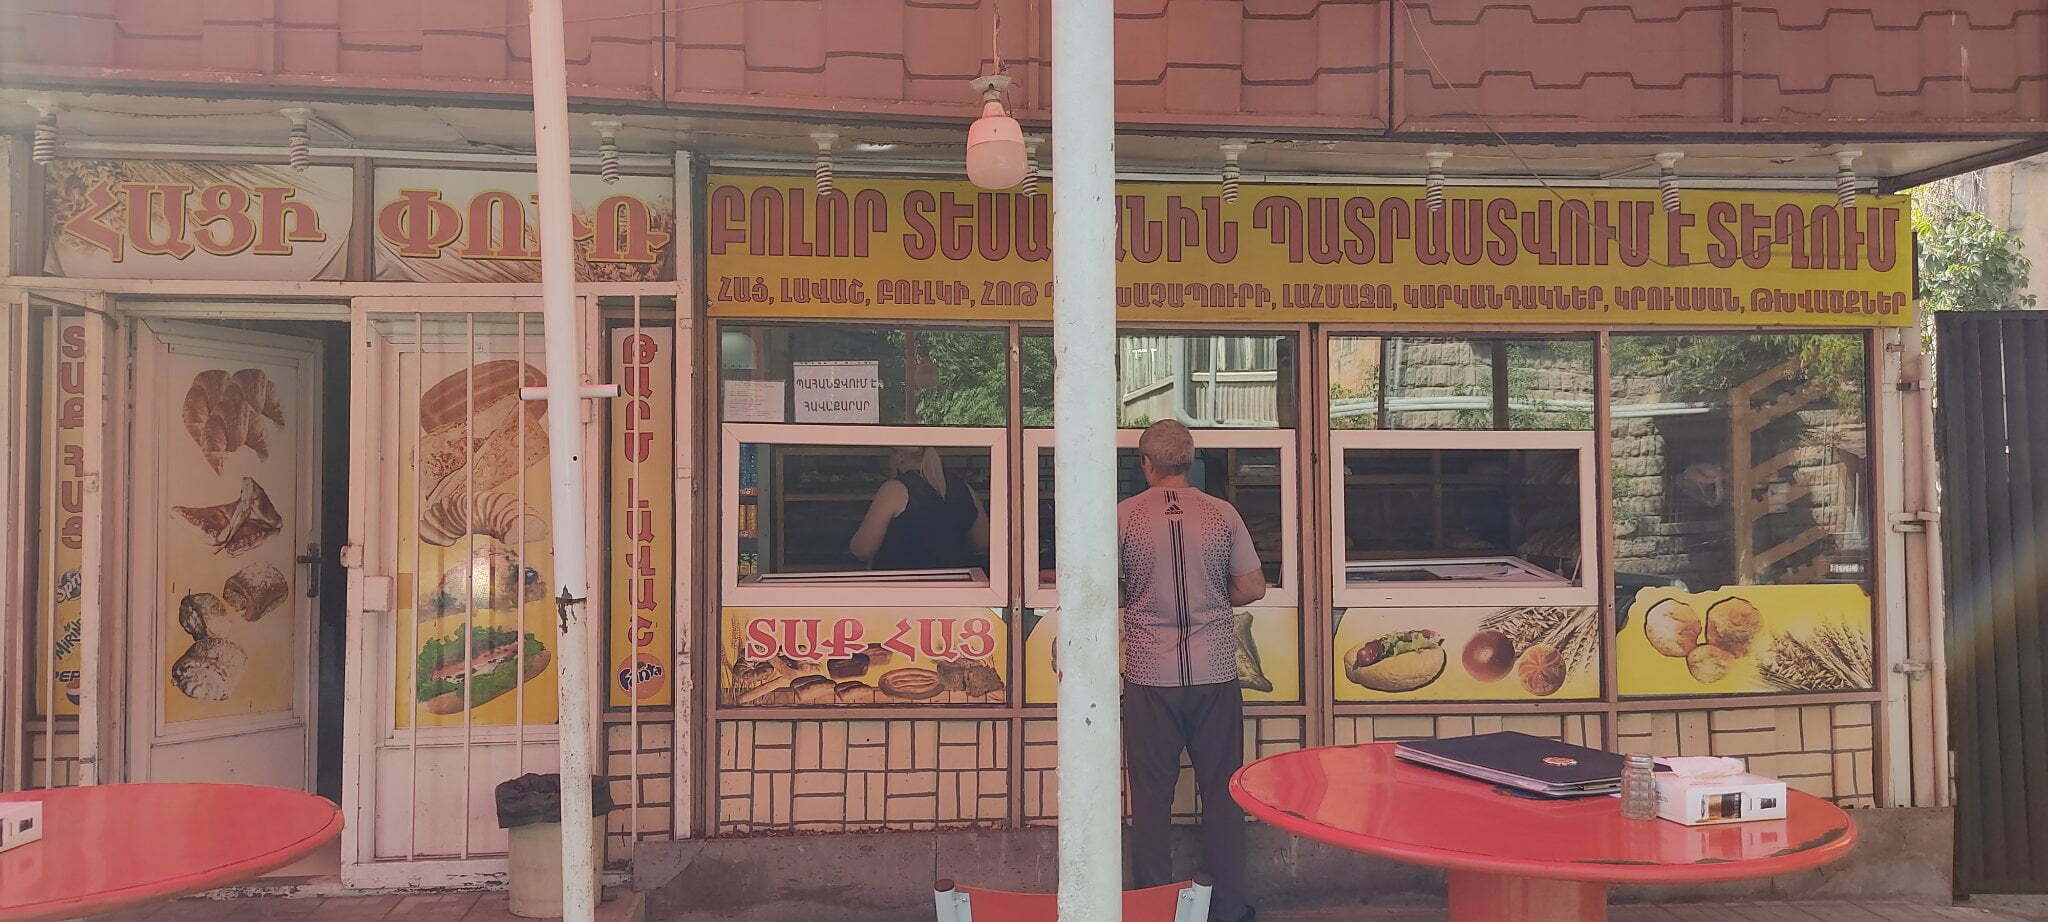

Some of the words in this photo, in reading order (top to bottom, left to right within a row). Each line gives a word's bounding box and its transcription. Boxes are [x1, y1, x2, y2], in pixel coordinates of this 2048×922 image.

[64, 180, 327, 263] ՀԱՑԻ
[710, 185, 888, 258] ԲՈԼՈՐ
[902, 189, 1239, 264] ՏԵՍԱՆԻՆ
[1252, 195, 1655, 267] ՊԱՏՐԱՍՏՎՈՒՄ
[1666, 206, 1696, 267] Է
[1706, 201, 1901, 273] ՏԵՂՈՒՄ
[717, 276, 775, 305] ՀԱՑ,
[780, 277, 871, 307] ԼԱՎԱՇ,
[876, 279, 976, 308] ԲՈՒԼԿԻ,
[980, 280, 1039, 307] ՀՈԹ
[1282, 283, 1398, 312] ԼԱՀՄԱՋՈ,
[1403, 284, 1609, 313] ԿԱՐԿԱՆԴԱԿՆԵՐ,
[1614, 286, 1745, 314] ԿՐՈՒԱՍԱՆ,
[1750, 287, 1907, 315] ԹԽՎԱԾՔՆԵՐ
[622, 333, 658, 464] ԹԱՐՄ
[625, 477, 658, 648] ԼԱՎԱՇ
[745, 616, 868, 662] ՏԱՔ
[880, 617, 996, 663] ՀԱՑ
